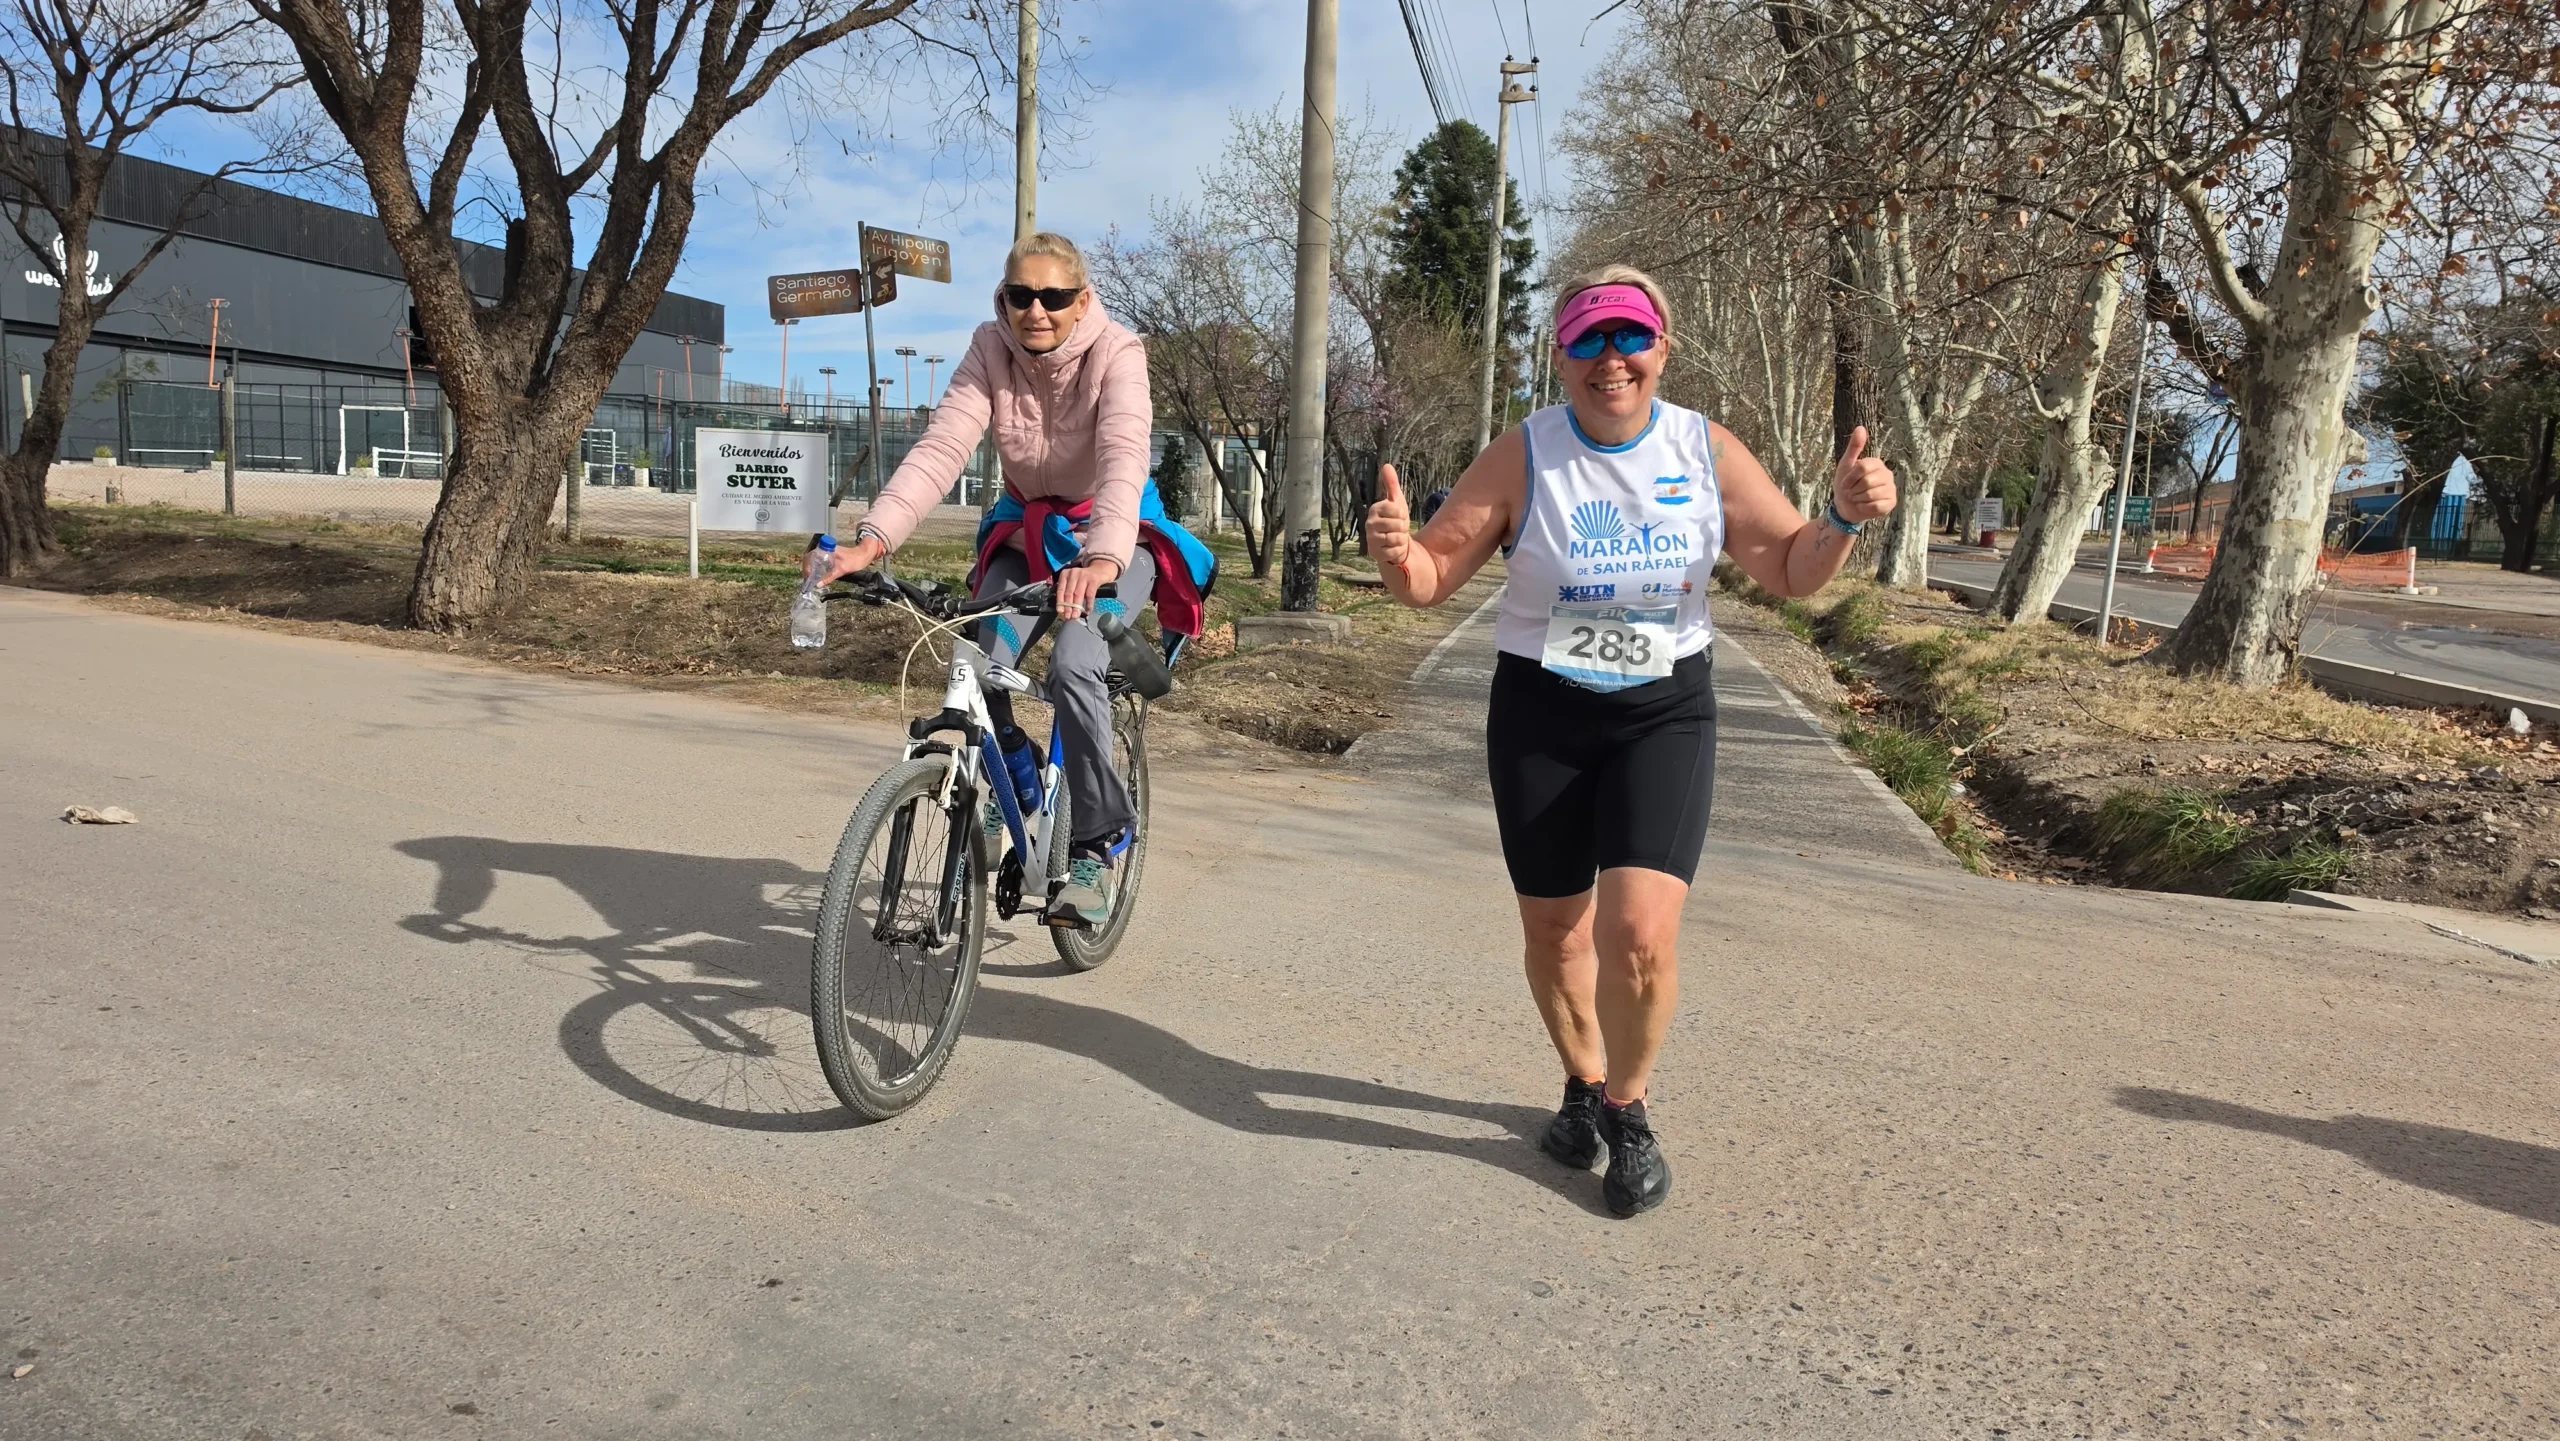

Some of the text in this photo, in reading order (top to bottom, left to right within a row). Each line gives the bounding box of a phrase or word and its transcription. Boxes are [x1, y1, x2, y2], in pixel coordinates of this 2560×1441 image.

[872, 230, 945, 255] Av. Hipolito
[872, 243, 942, 267] Irigoyen
[25, 270, 61, 288] wes
[85, 273, 113, 296] lub
[776, 274, 846, 291] Santiago
[719, 443, 804, 460] Bienvenidos
[735, 464, 788, 474] BARRIO
[727, 475, 797, 490] SUTER
[1593, 562, 1627, 575] SAN
[1632, 557, 1690, 572] RAFAEL
[1579, 584, 1615, 595] UTN
[1567, 626, 1651, 665] 283
[905, 1048, 948, 1101] CHAOYANG
